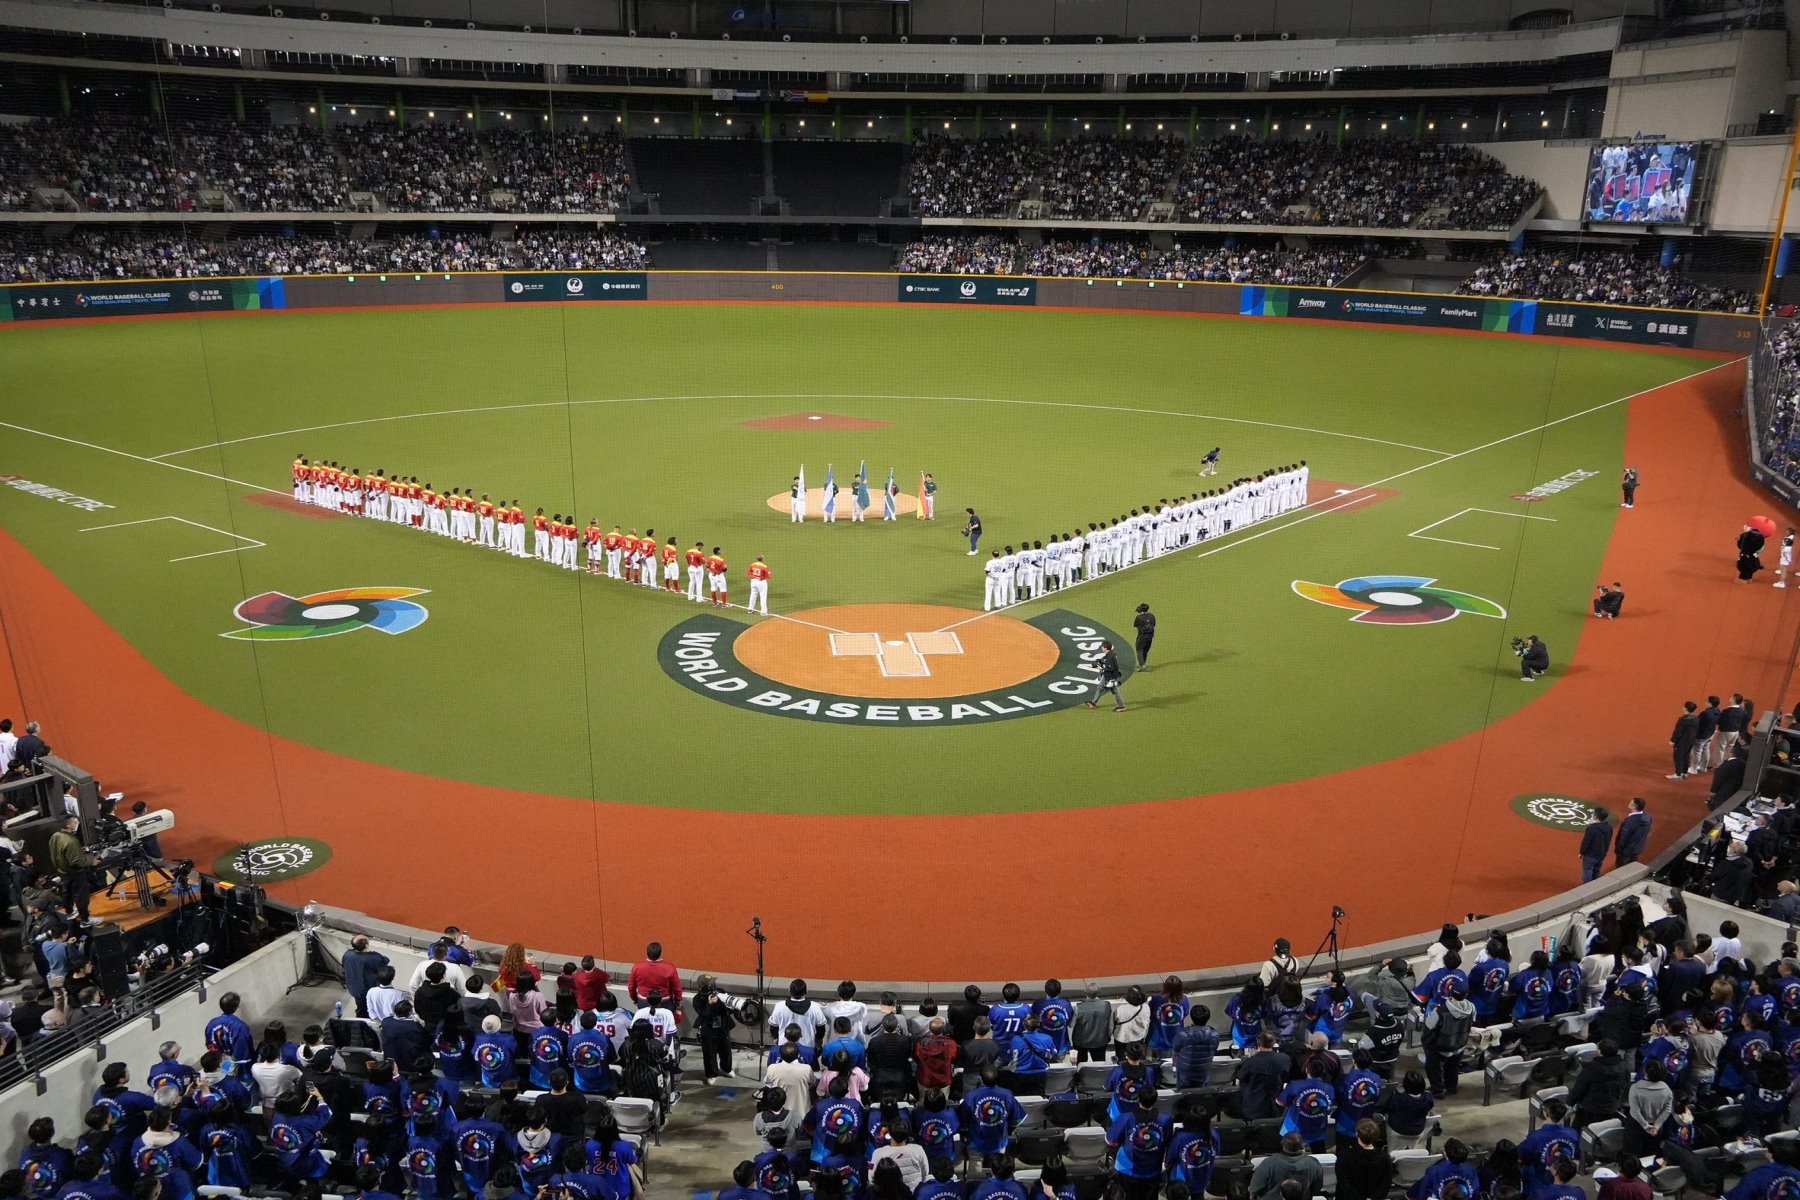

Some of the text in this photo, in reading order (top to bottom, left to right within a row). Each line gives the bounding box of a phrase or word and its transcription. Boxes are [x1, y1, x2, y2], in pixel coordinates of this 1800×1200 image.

[1299, 298, 1326, 308] Amway
[1440, 307, 1477, 318] FamilyMart
[674, 631, 748, 692] WORLD
[746, 689, 1053, 722] BASEBALL
[1004, 1018, 1020, 1032] 77
[828, 1103, 851, 1112] BASEBALL
[462, 1129, 487, 1137] BASEBALL
[593, 1157, 618, 1176] 24
[988, 1191, 1015, 1200] BASEBALL
